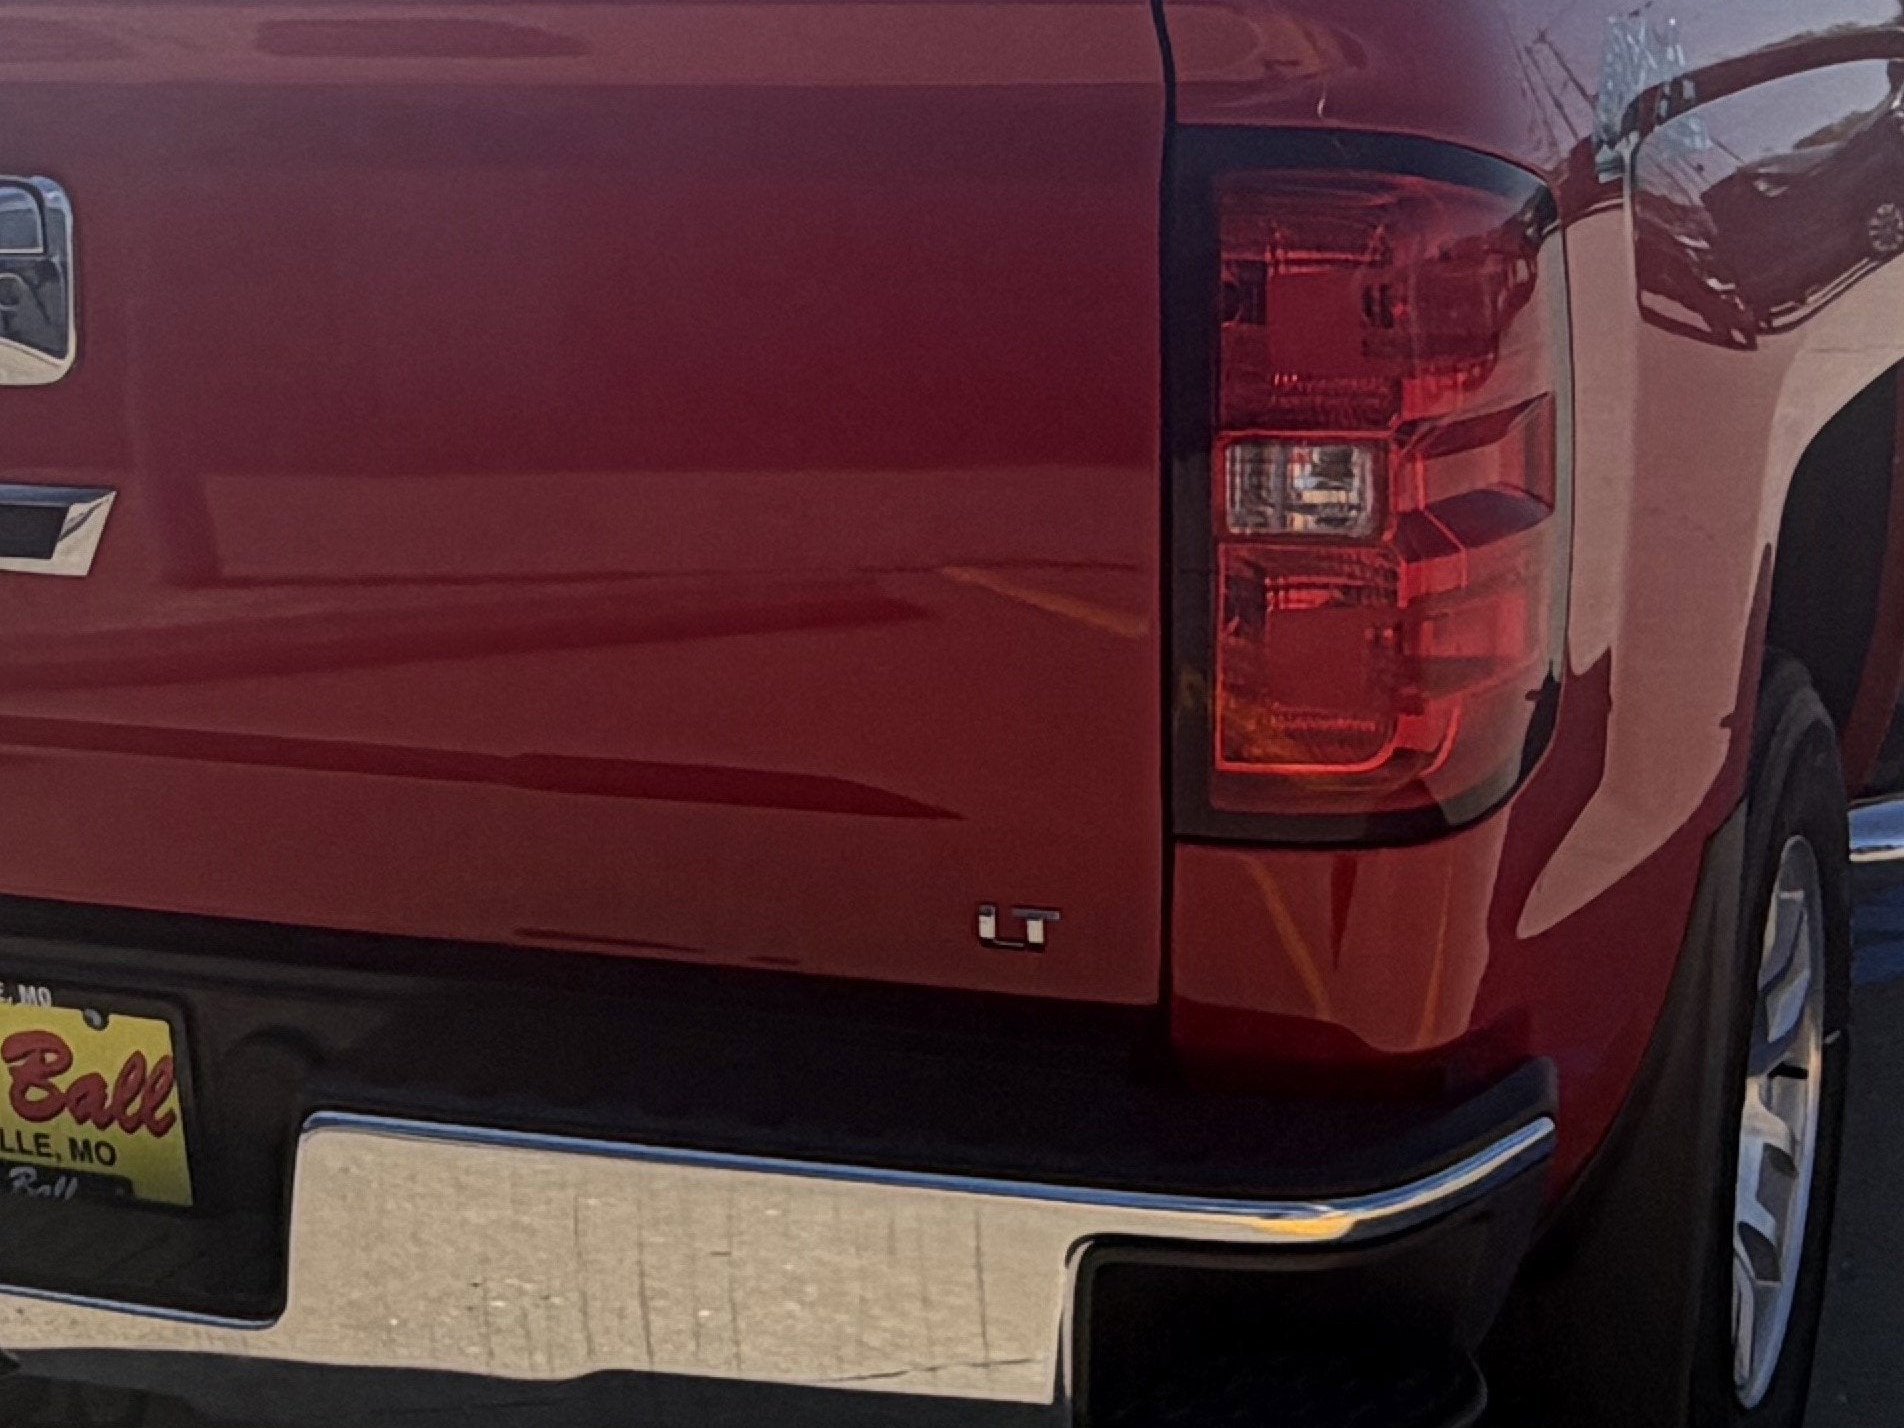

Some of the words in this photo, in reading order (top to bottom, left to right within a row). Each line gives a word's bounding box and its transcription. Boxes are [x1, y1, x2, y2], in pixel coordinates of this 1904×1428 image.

[977, 904, 1061, 952] LT
[18, 983, 52, 1008] MO
[0, 1029, 178, 1138] Ball
[69, 1137, 117, 1167] MO
